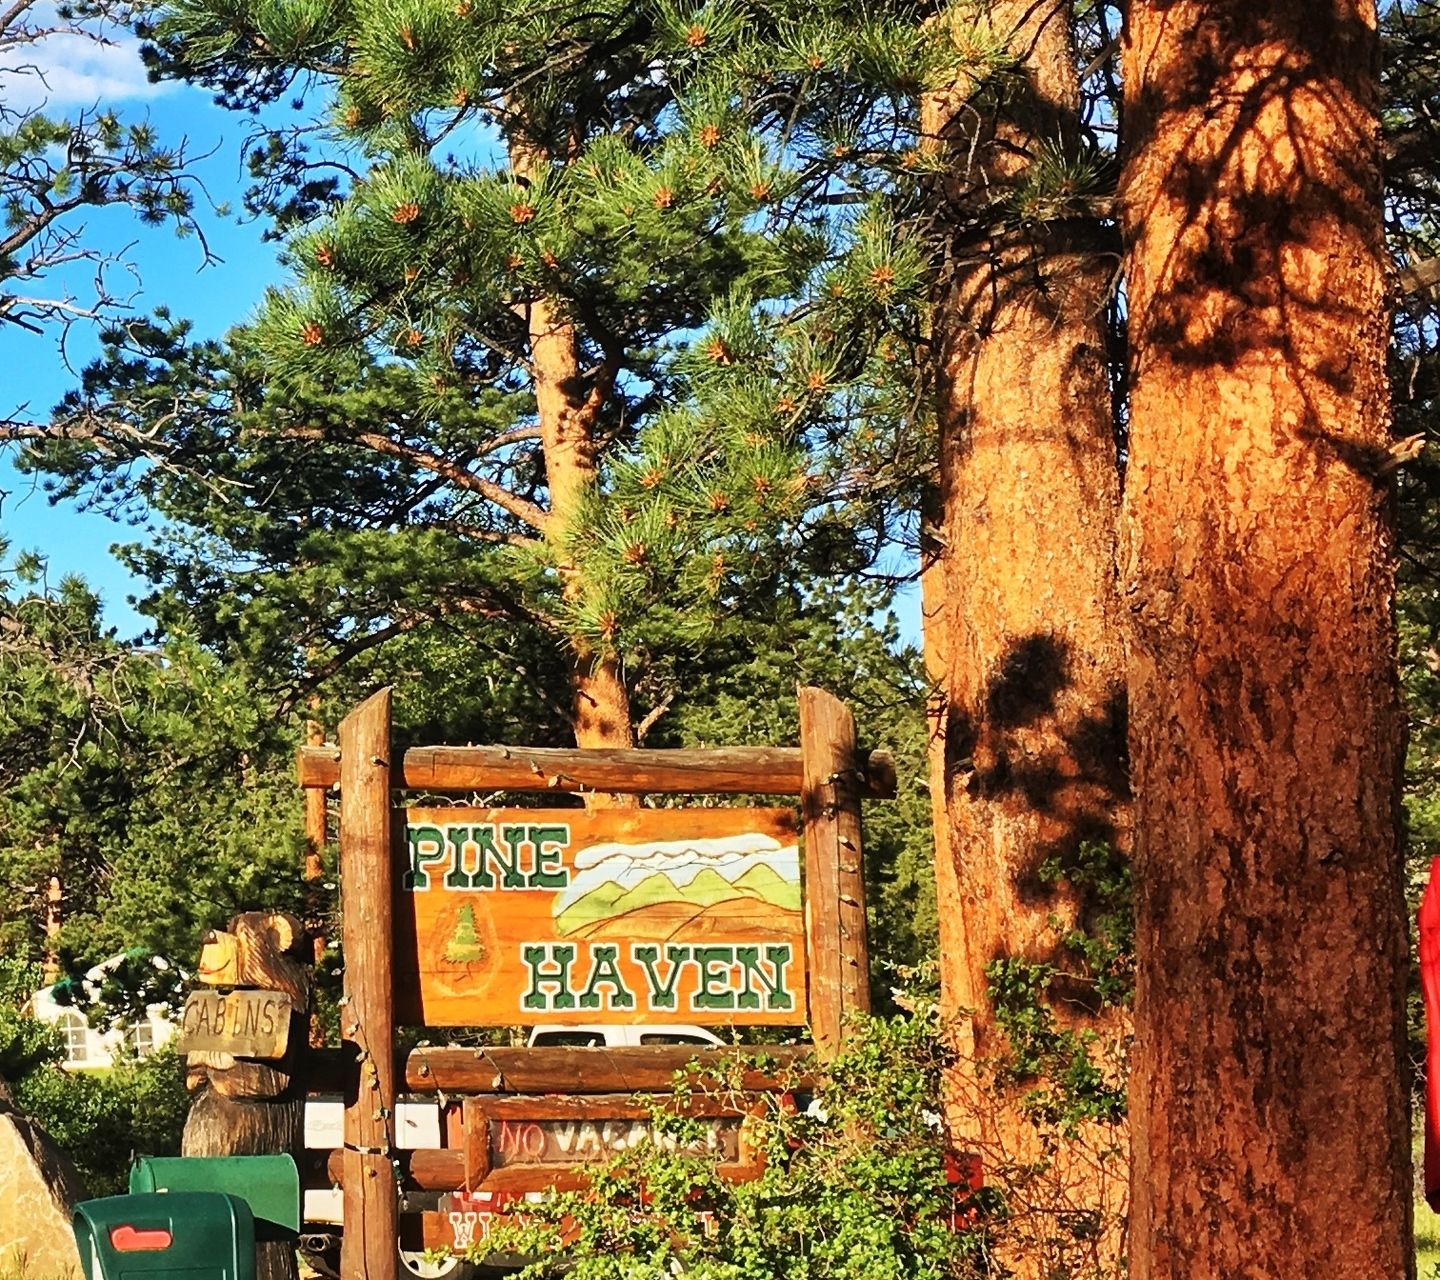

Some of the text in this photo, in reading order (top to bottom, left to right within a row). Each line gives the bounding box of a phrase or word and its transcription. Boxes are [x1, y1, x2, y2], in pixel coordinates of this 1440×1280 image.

[403, 823, 570, 891] PINE
[520, 942, 796, 1012] HAVEN
[499, 1120, 722, 1156] NO VACANY
